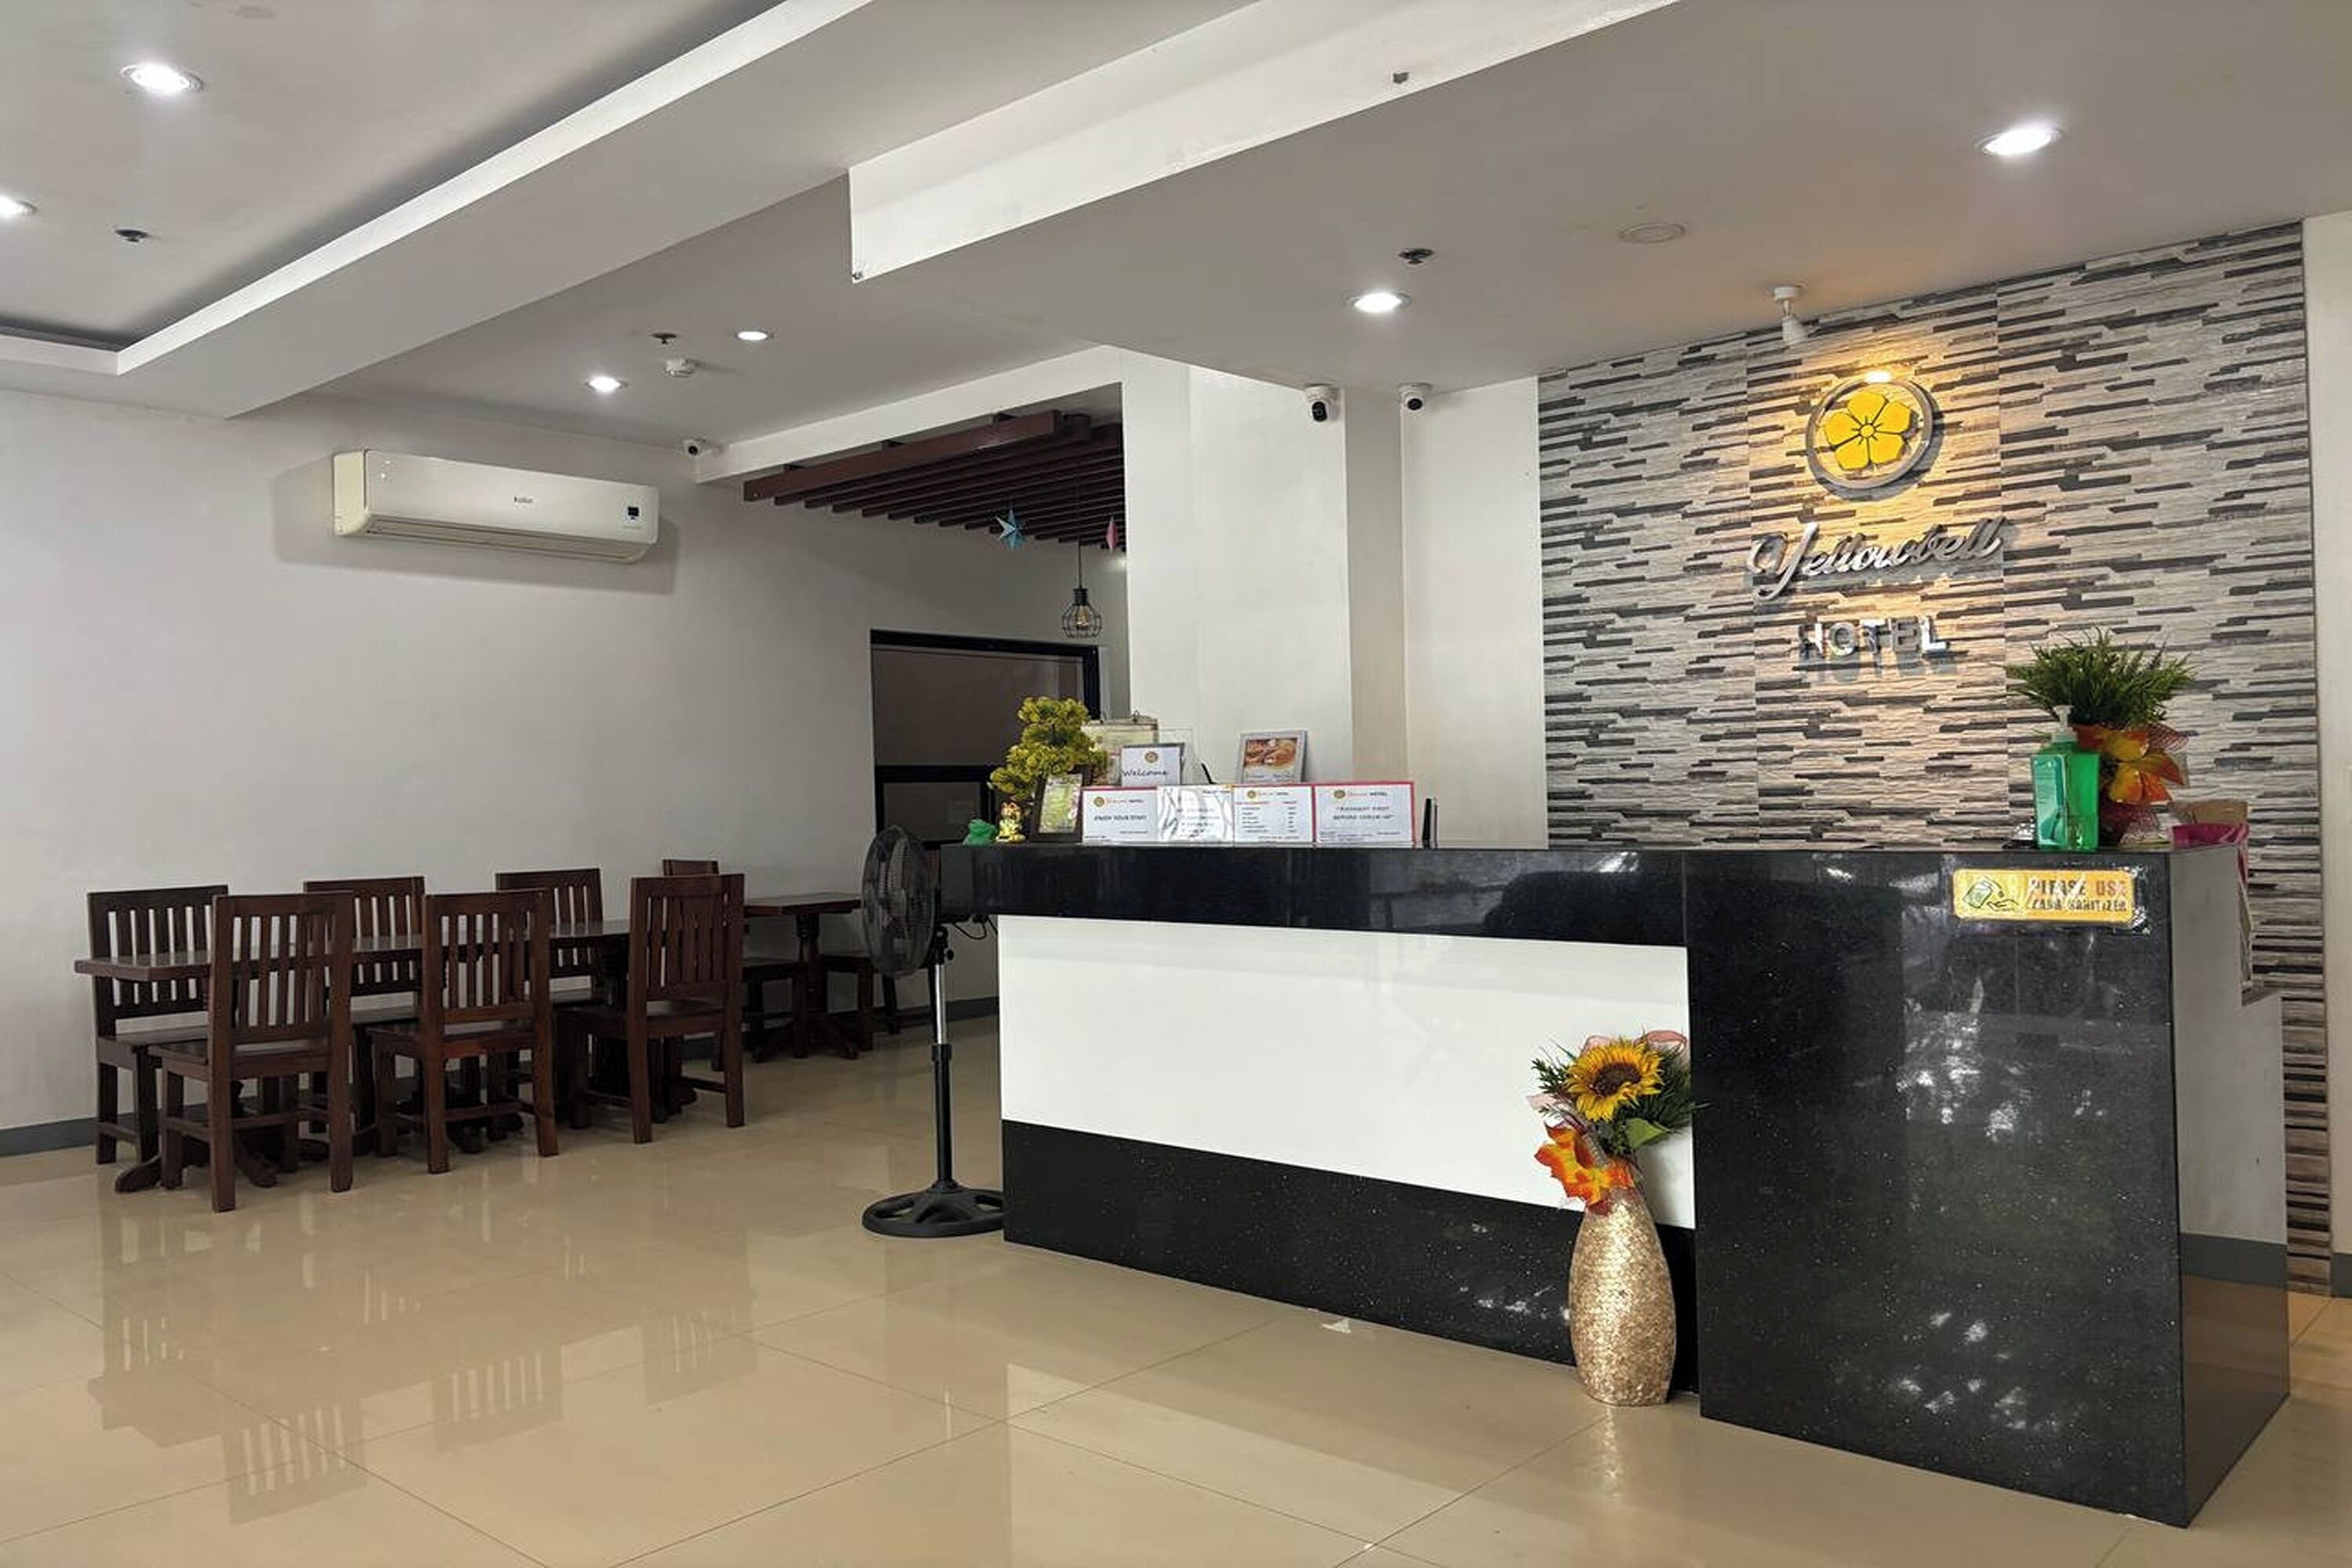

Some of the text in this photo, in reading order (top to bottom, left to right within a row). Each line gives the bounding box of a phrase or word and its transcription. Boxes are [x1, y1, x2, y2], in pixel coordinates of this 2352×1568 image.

[1748, 515, 2007, 601] Yellowbell
[1798, 615, 1951, 659] HOTEL
[1122, 768, 1171, 777] Welcome
[2096, 880, 2127, 897] USE
